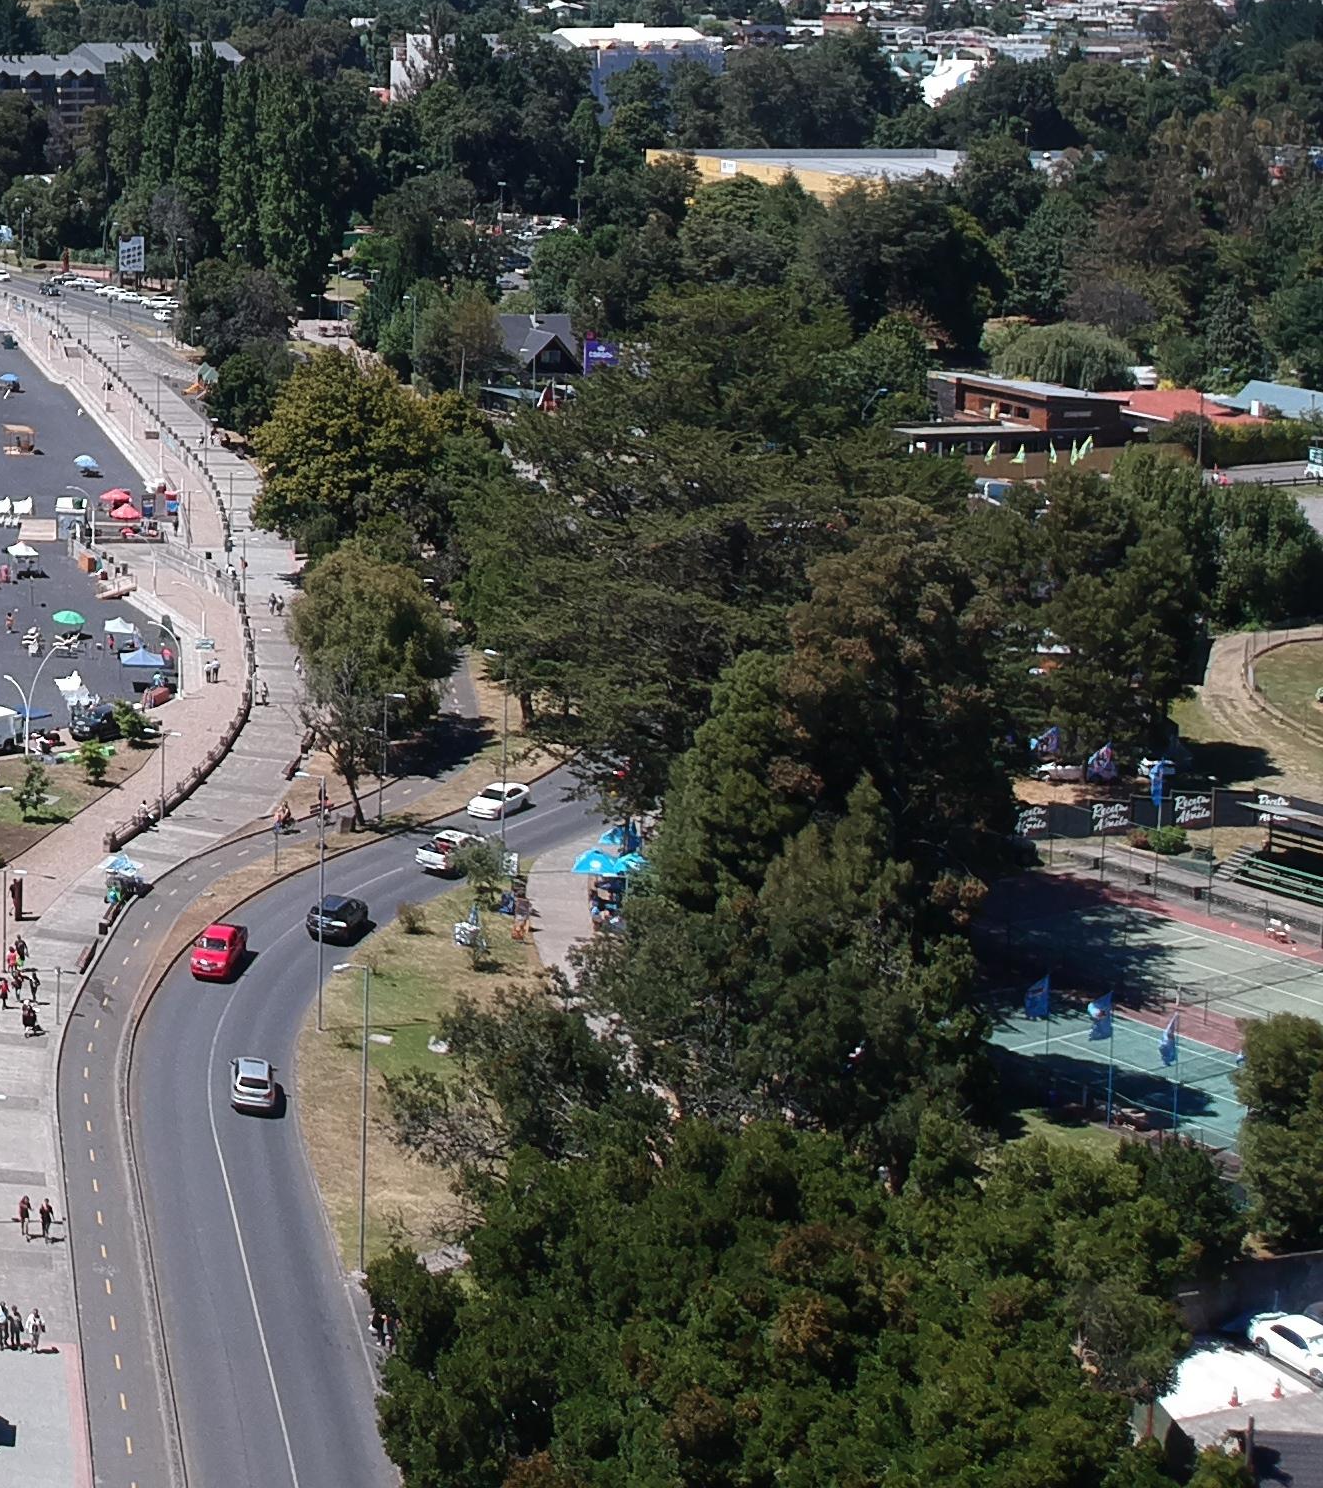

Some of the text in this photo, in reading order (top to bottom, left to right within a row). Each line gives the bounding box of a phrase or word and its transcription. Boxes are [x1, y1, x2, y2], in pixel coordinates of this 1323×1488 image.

[1175, 795, 1210, 811] Receta
[1018, 806, 1046, 818] eceta
[1092, 803, 1128, 819] Receta
[1176, 808, 1210, 823] Abuelo
[1093, 816, 1128, 831] Abuelo
